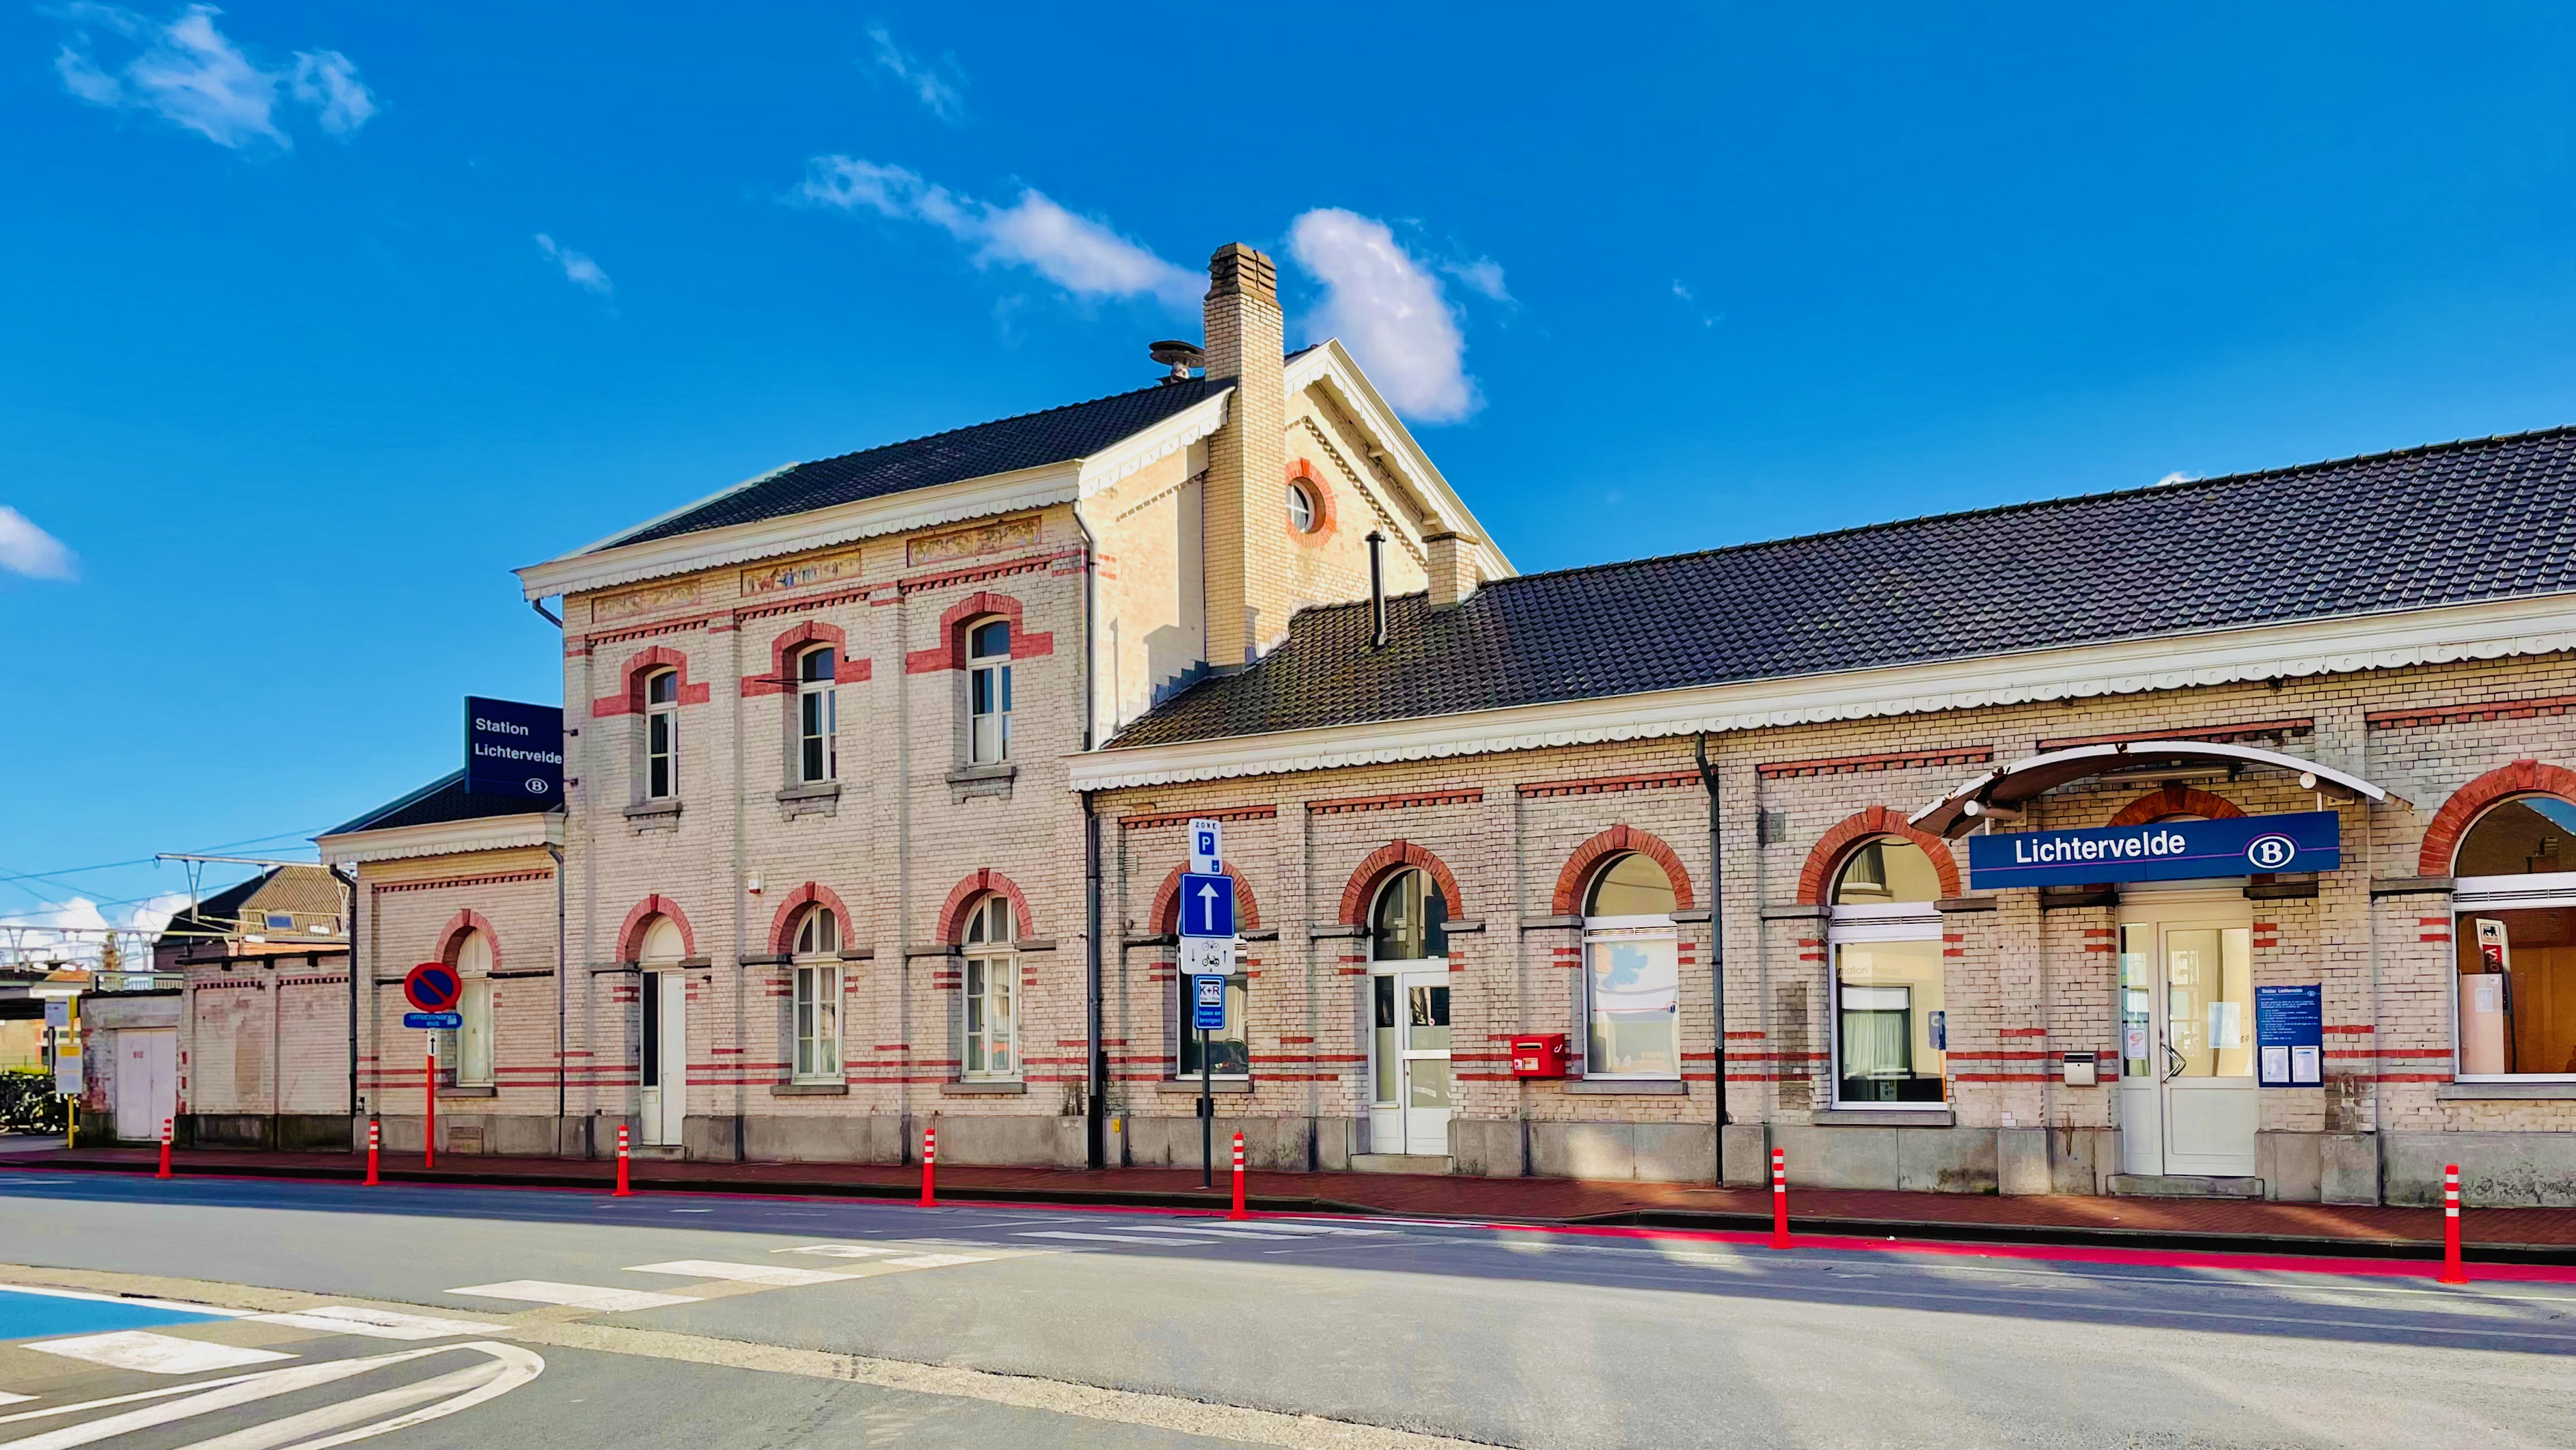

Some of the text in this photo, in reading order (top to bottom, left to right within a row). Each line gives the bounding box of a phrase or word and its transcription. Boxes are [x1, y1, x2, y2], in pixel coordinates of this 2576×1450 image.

[476, 717, 529, 736] Station
[475, 743, 562, 764] Lichtervelde
[1202, 836, 1211, 851] P
[2016, 830, 2185, 863] Lichtervelde
